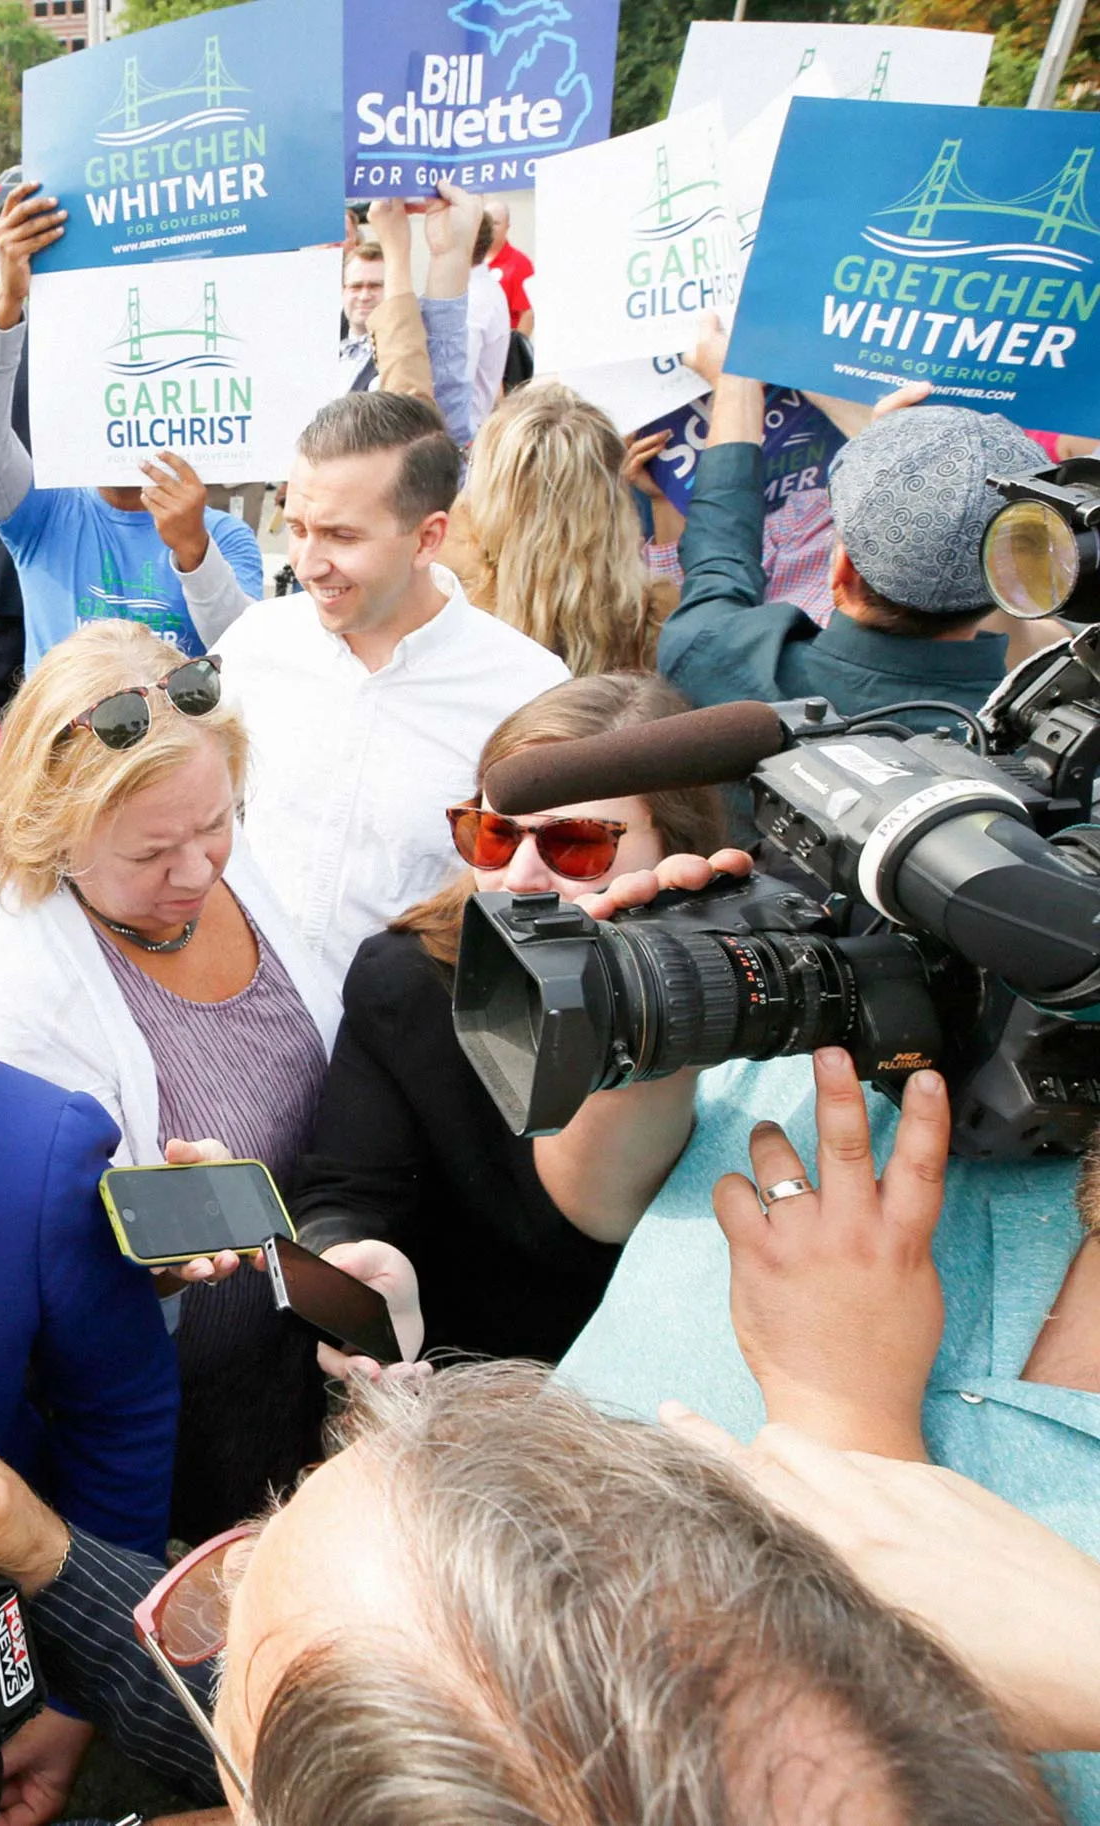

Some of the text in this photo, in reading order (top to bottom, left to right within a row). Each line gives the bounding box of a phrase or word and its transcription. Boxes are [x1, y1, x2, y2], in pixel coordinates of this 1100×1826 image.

[421, 54, 484, 106] Bill
[356, 91, 562, 149] Schuette
[85, 124, 267, 188] GRETCHEN
[354, 159, 538, 186] FOR GOVERNO
[85, 163, 269, 227] WHITMER
[112, 224, 247, 254] WWW.GRETCHENWHITMER.COM
[126, 208, 241, 237] FOR GOVERNOR
[833, 255, 1100, 321] GRETCHEN
[823, 294, 1077, 369] WHITMER
[857, 349, 1018, 385] FOR GOVERNOR
[104, 377, 252, 418] GARLIN
[107, 415, 252, 448] GILCHRIST
[877, 1059, 932, 1070] FUJINON
[6, 1607, 28, 1661] FOX
